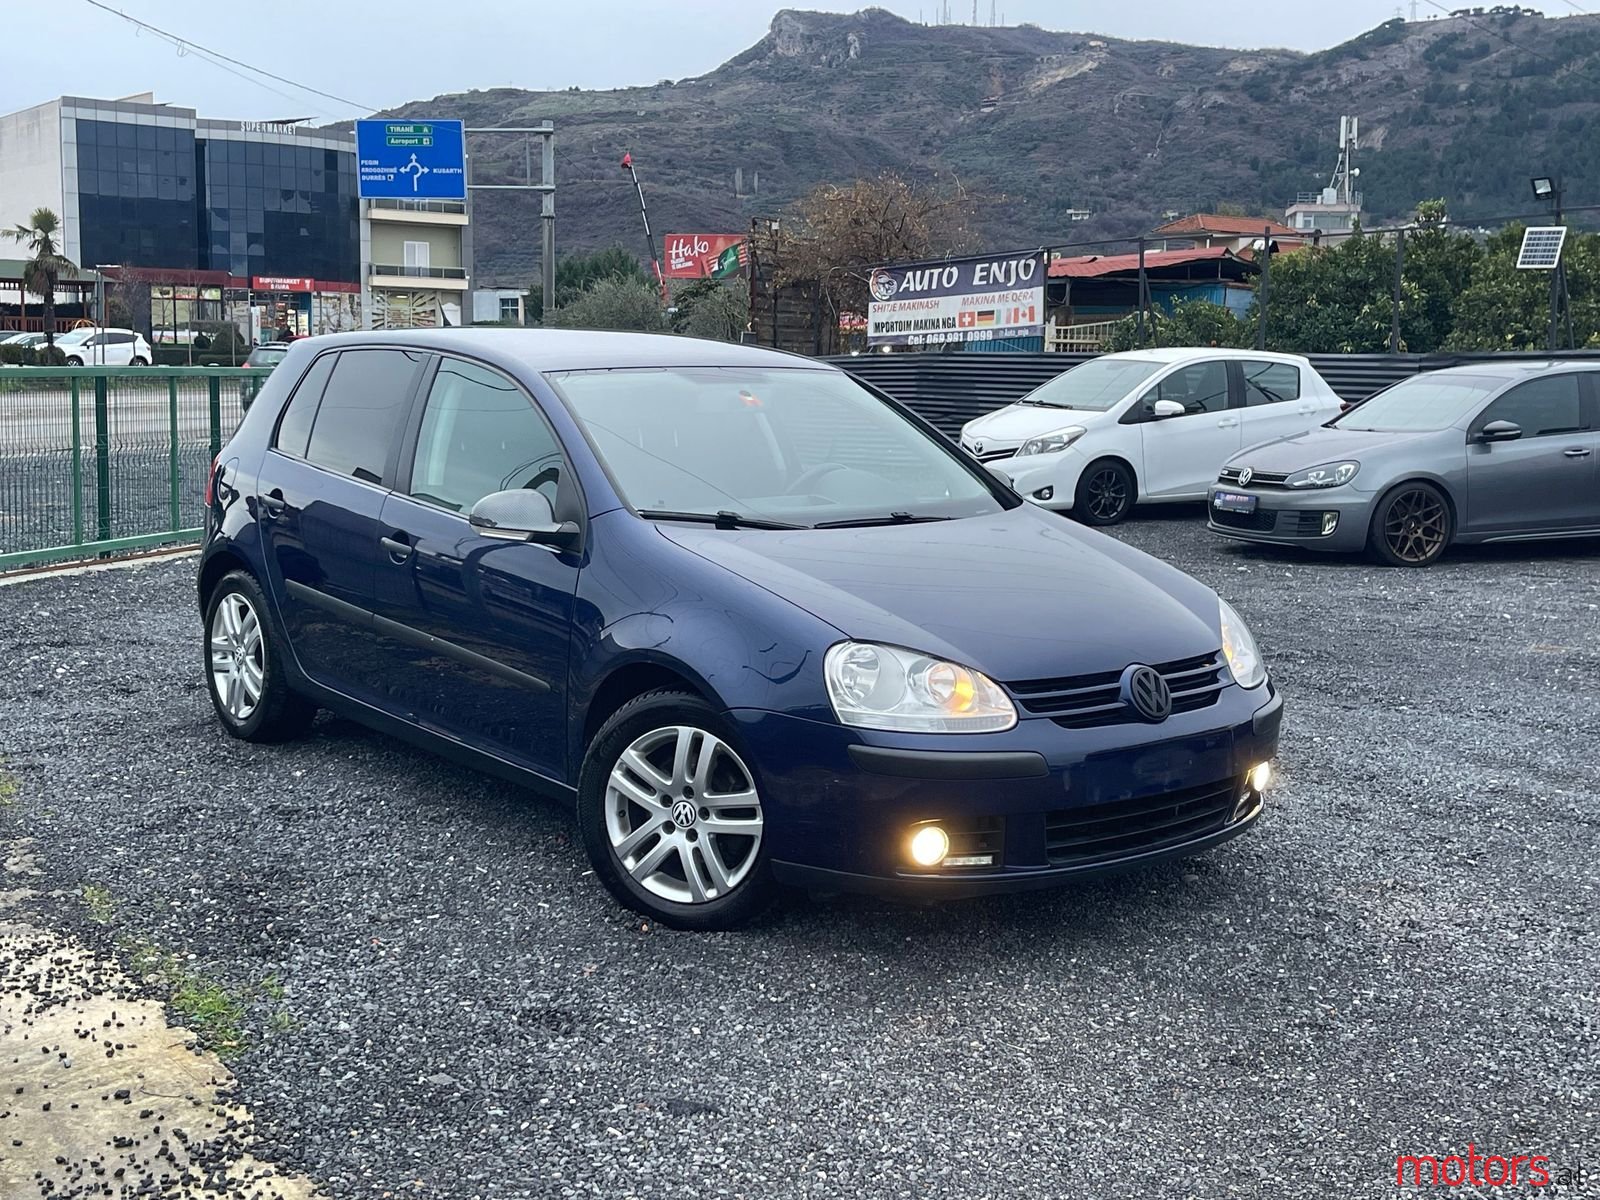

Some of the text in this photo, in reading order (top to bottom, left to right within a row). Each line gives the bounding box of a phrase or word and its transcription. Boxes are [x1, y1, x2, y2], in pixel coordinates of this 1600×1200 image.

[240, 120, 297, 135] SUPERMARKET
[668, 235, 709, 259] Hako
[899, 258, 1037, 293] AUTO ENJO
[872, 300, 940, 313] SHITJE MAKINASH
[961, 295, 996, 306] MAKINA
[997, 293, 1010, 303] ME
[912, 318, 941, 331] MAKINA
[941, 316, 957, 329] NGA
[907, 335, 925, 345] Cel:
[967, 330, 993, 341] 0999
